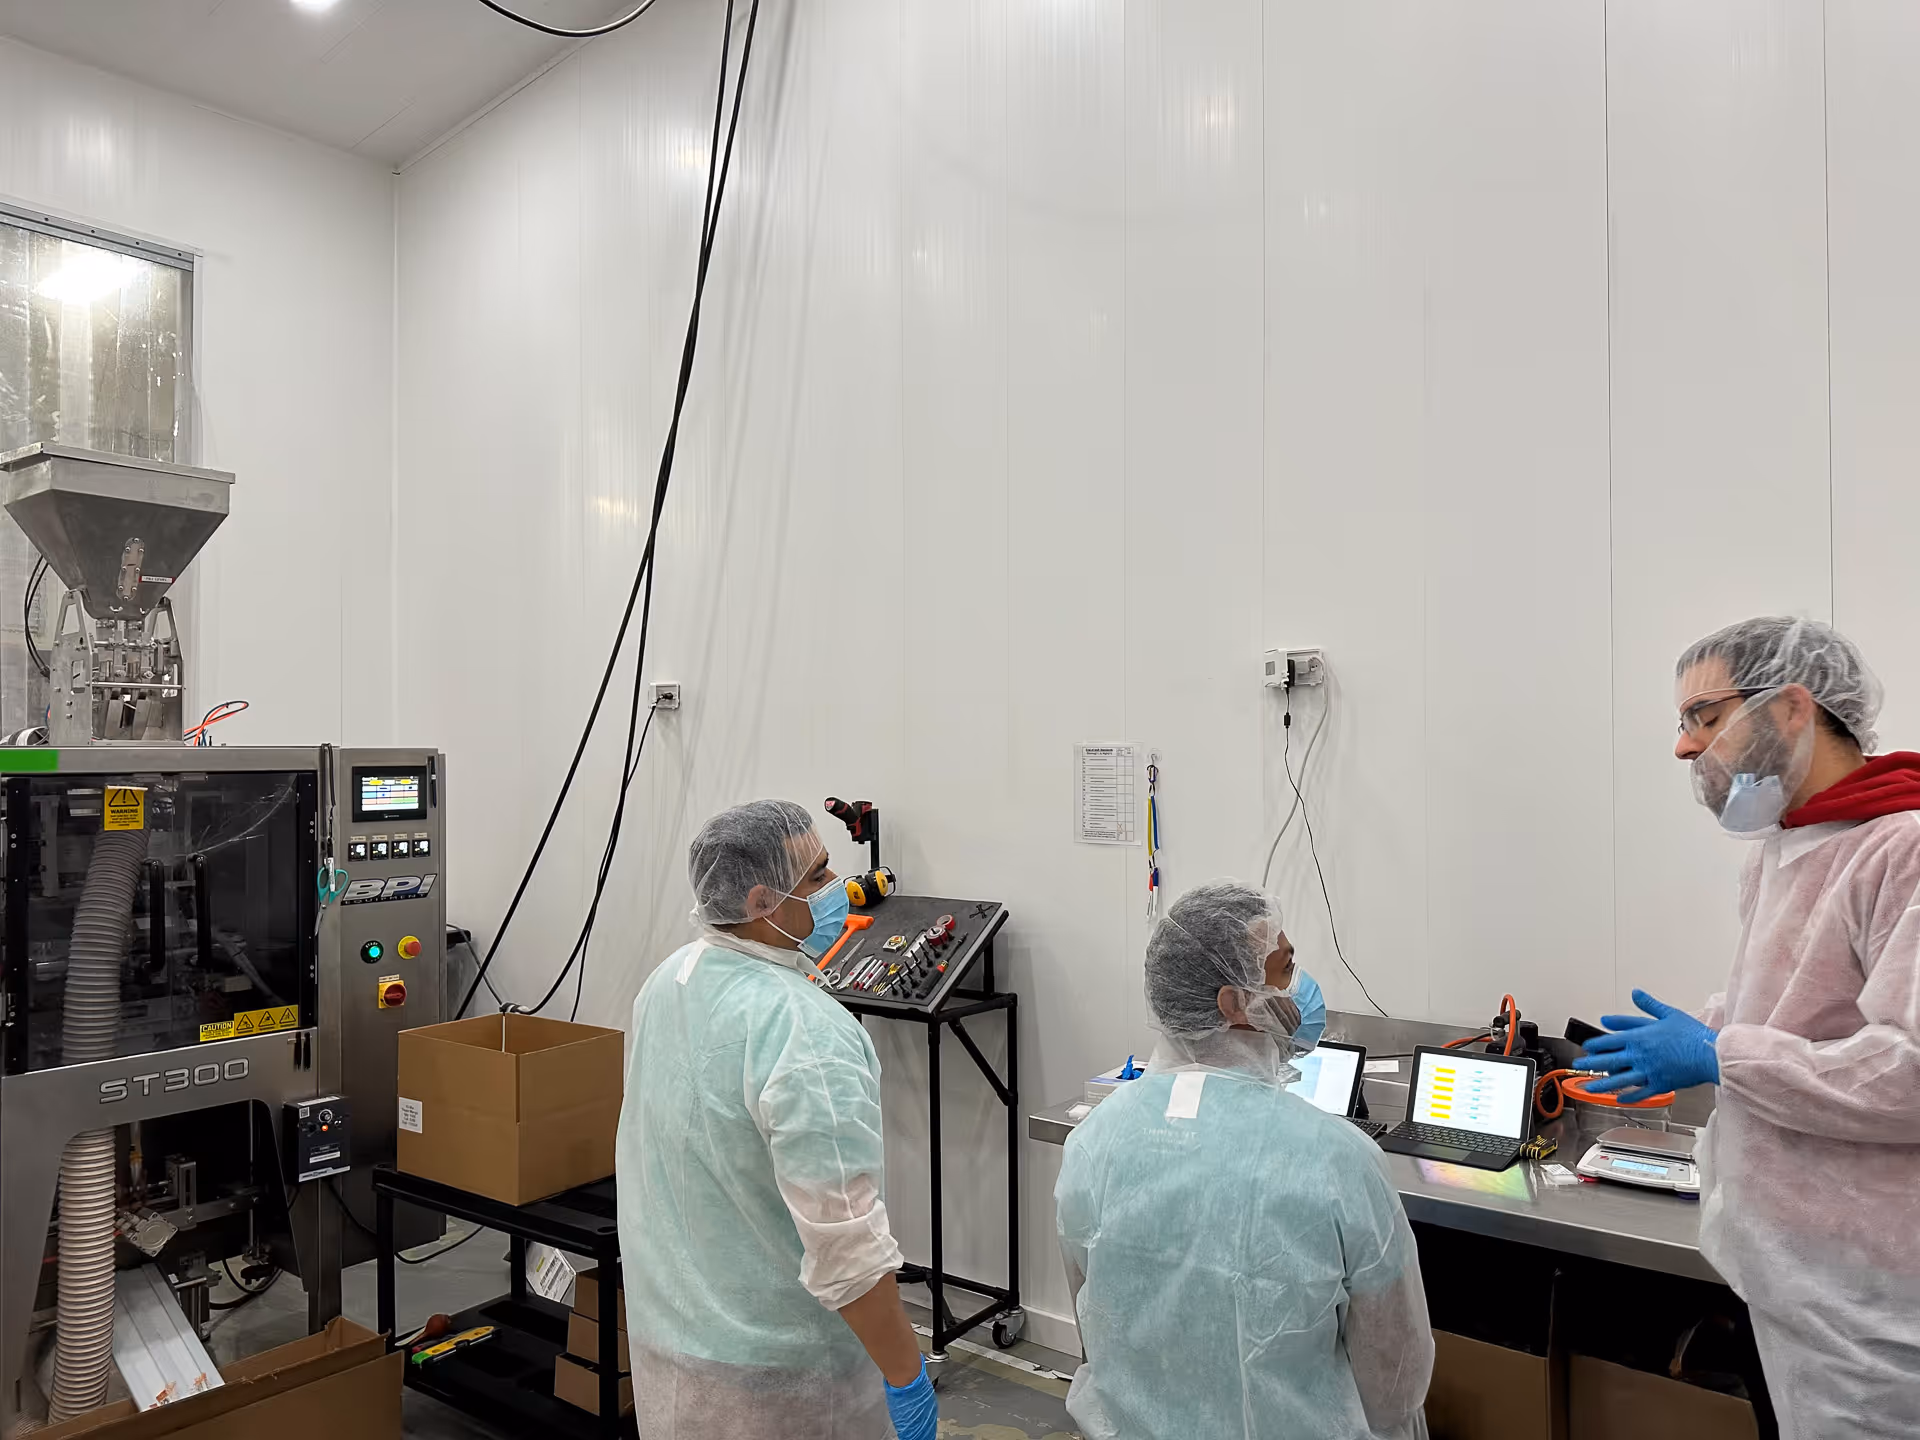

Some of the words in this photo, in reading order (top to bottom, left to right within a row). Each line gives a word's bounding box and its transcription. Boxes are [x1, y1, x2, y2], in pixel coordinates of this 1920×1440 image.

[343, 873, 438, 901] BPI
[202, 1021, 233, 1032] CAUTION
[99, 1056, 250, 1105] ST300
